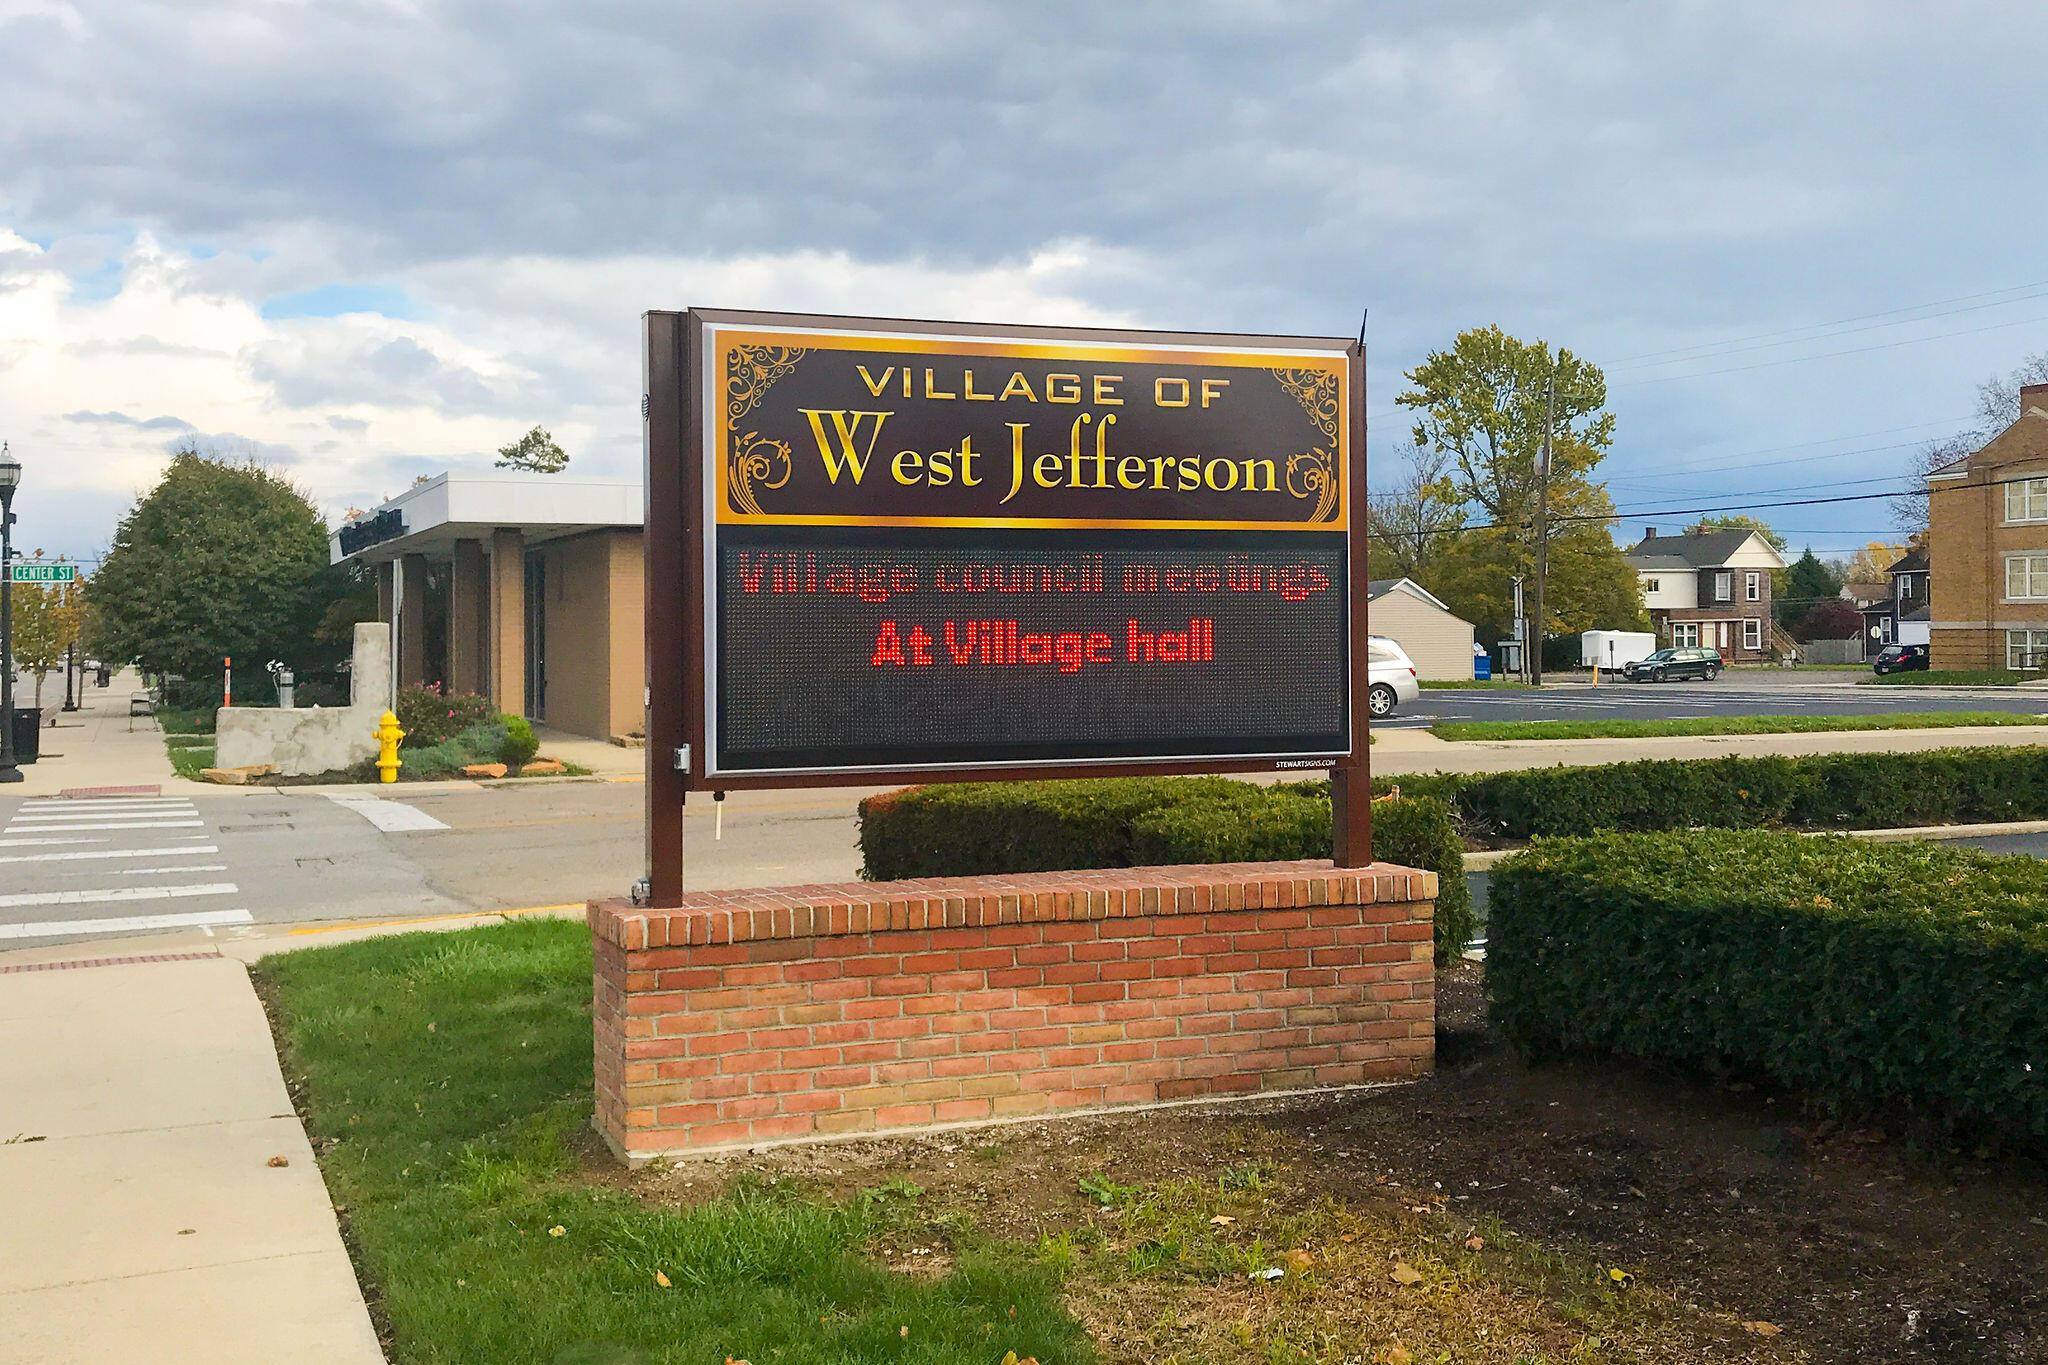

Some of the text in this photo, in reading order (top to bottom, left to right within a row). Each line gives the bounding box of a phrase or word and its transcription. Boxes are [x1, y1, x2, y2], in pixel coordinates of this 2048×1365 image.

[856, 365, 1231, 408] VILLAGE OF
[797, 408, 1281, 504] West Jefferson
[15, 567, 71, 580] CENTER ST
[739, 552, 1331, 602] Village council meetings
[870, 616, 1215, 674] At Village hall
[1275, 759, 1337, 769] STEWARTSIGNS.COM
